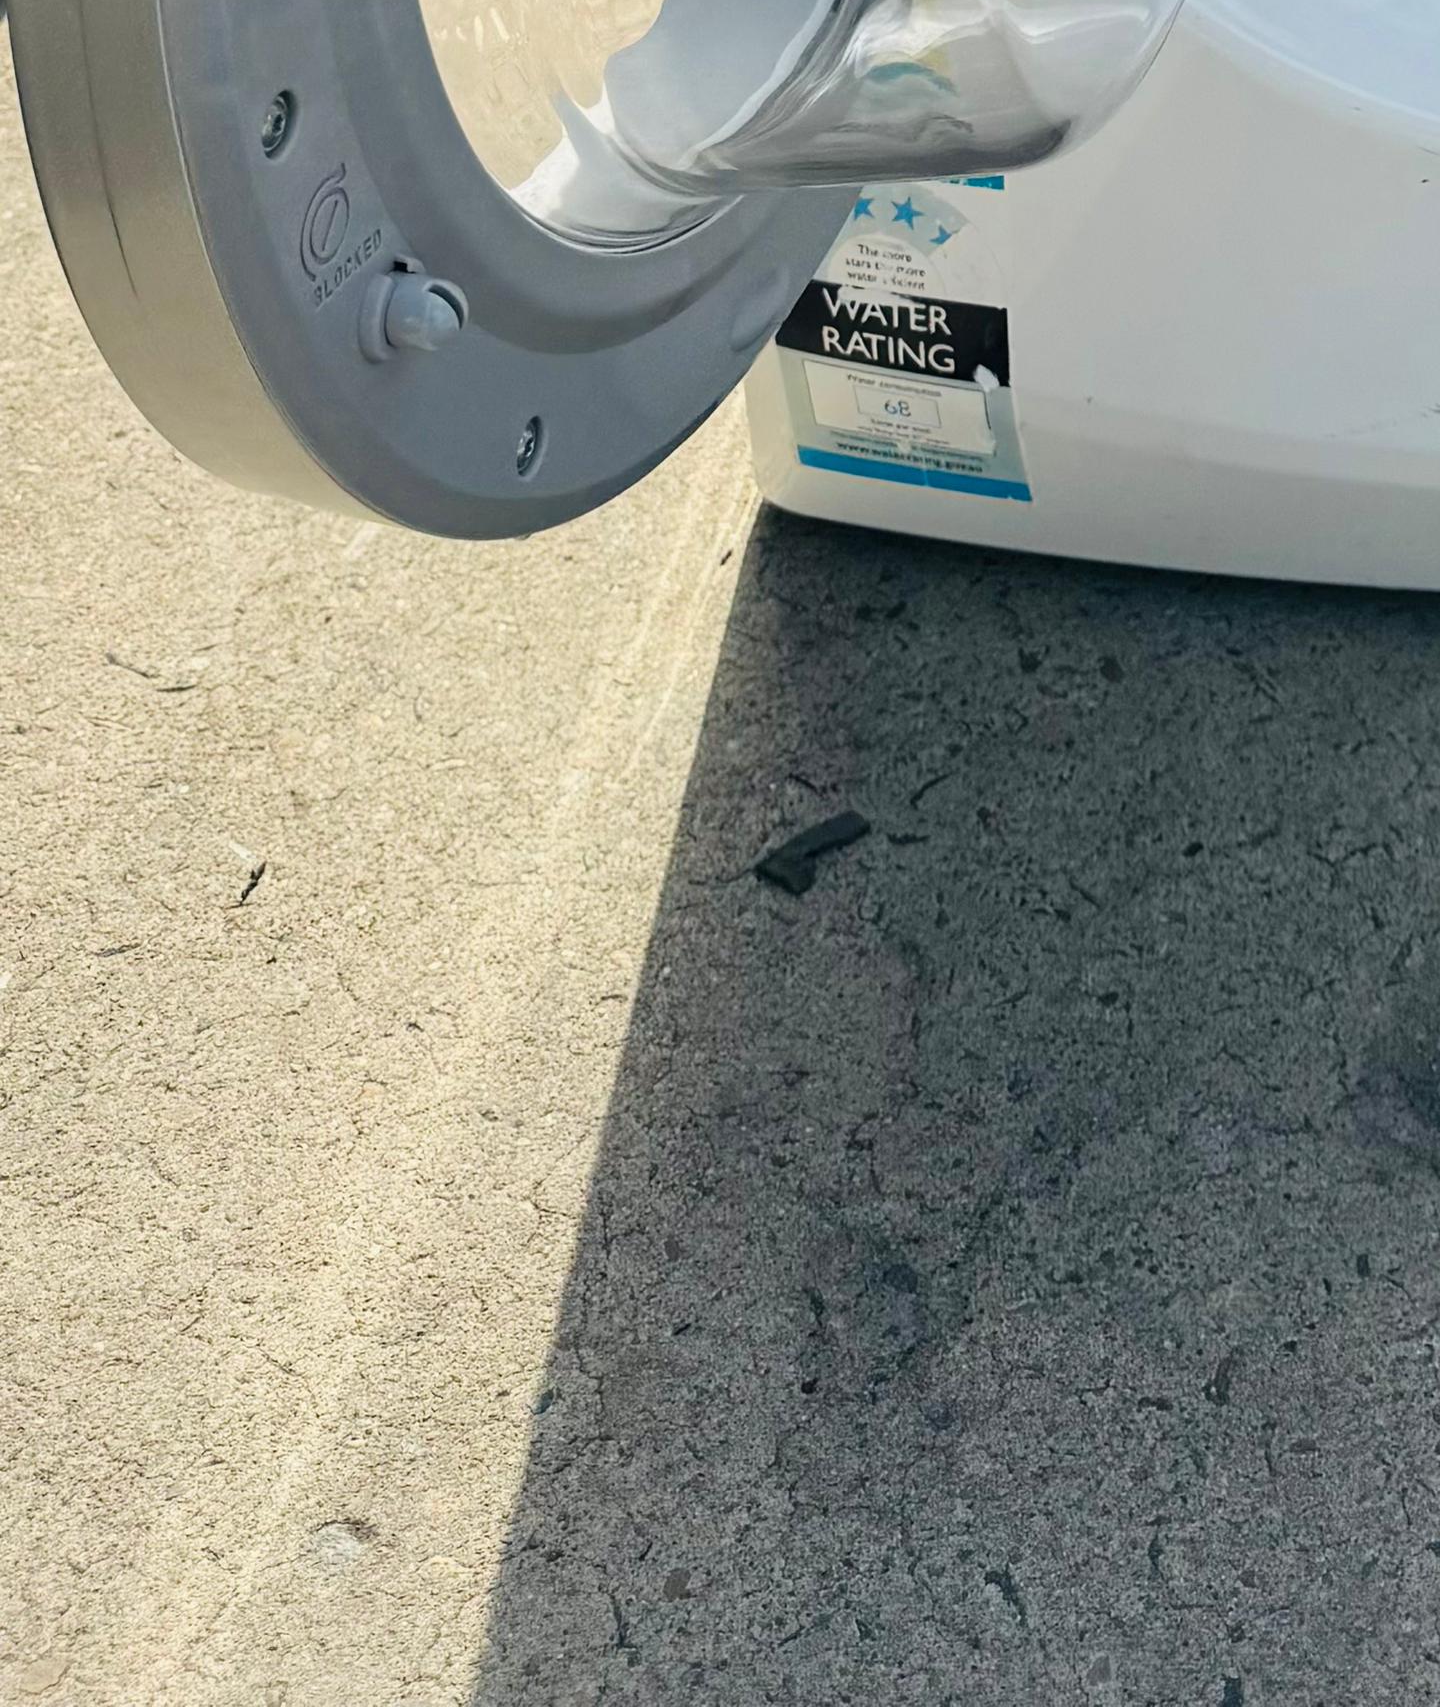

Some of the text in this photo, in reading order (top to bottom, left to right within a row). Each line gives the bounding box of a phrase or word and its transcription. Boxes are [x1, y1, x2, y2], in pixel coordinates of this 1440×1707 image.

[313, 228, 383, 308] BLOCKED
[823, 288, 952, 337] WATER
[822, 325, 956, 374] RATING
